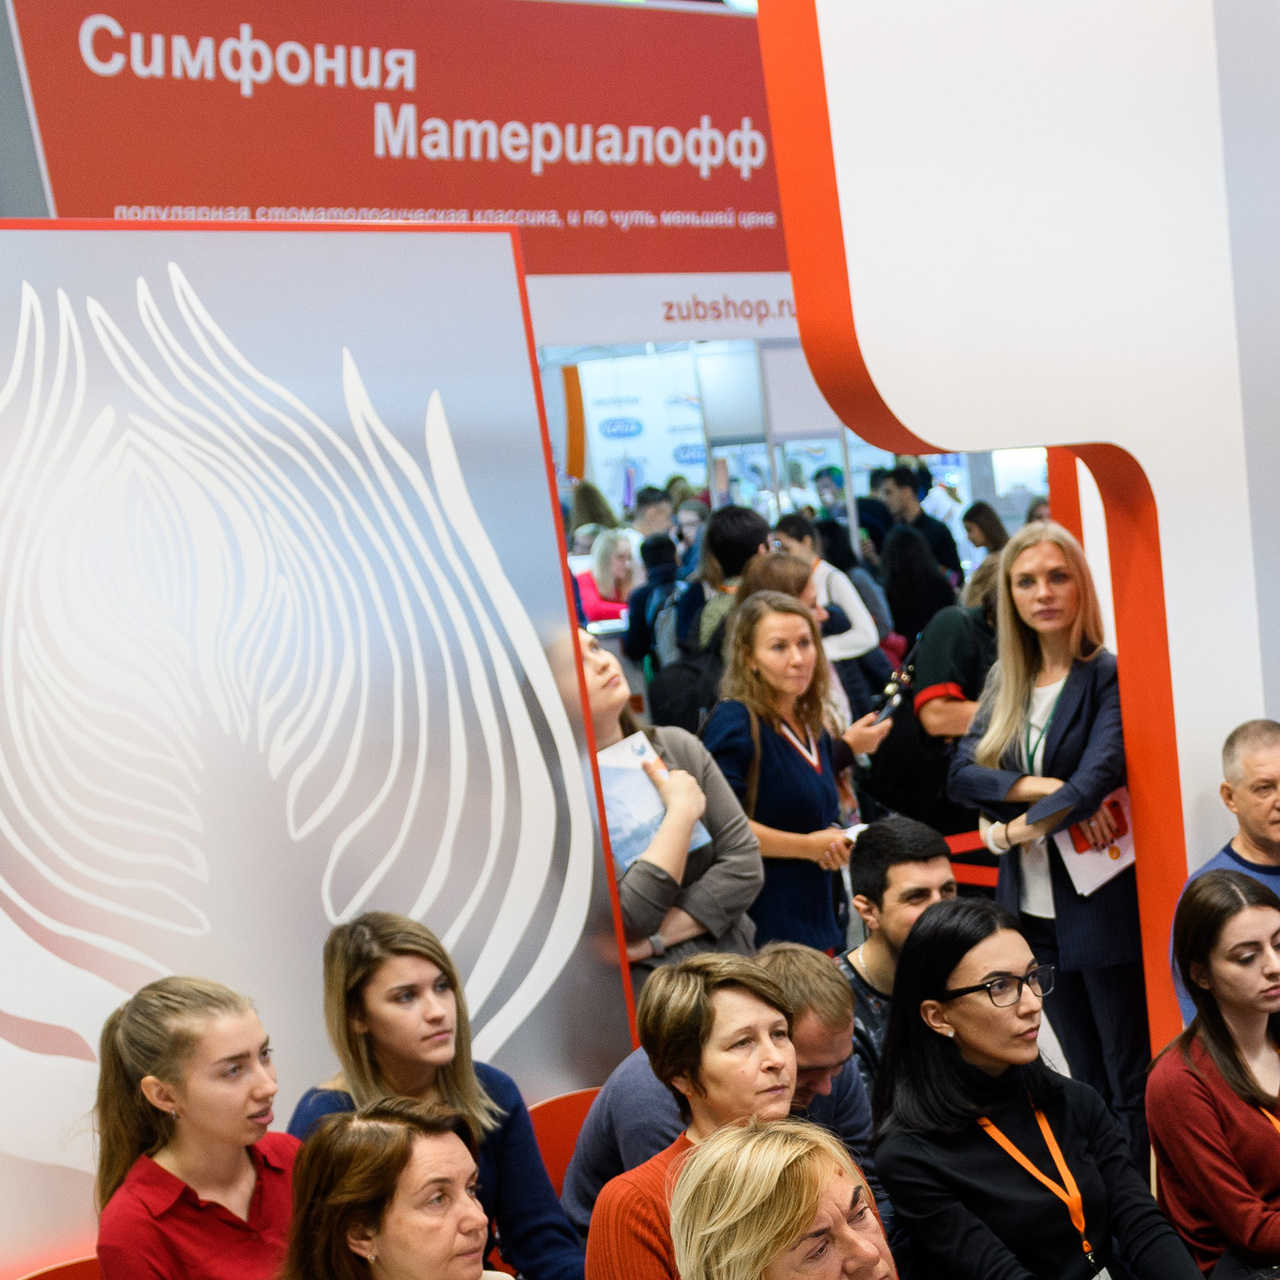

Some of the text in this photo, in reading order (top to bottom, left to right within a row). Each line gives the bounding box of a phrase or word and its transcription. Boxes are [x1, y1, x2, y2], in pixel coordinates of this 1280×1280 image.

[77, 14, 417, 97] Симфония
[373, 101, 768, 179] Материалофф
[113, 204, 250, 220] популярная
[473, 209, 564, 230] классика,
[567, 210, 581, 226] и
[584, 210, 608, 227] по
[610, 210, 657, 231] чуть
[660, 207, 735, 228] меньшей
[738, 211, 777, 231] цене
[662, 294, 797, 326] zubshop.ru
